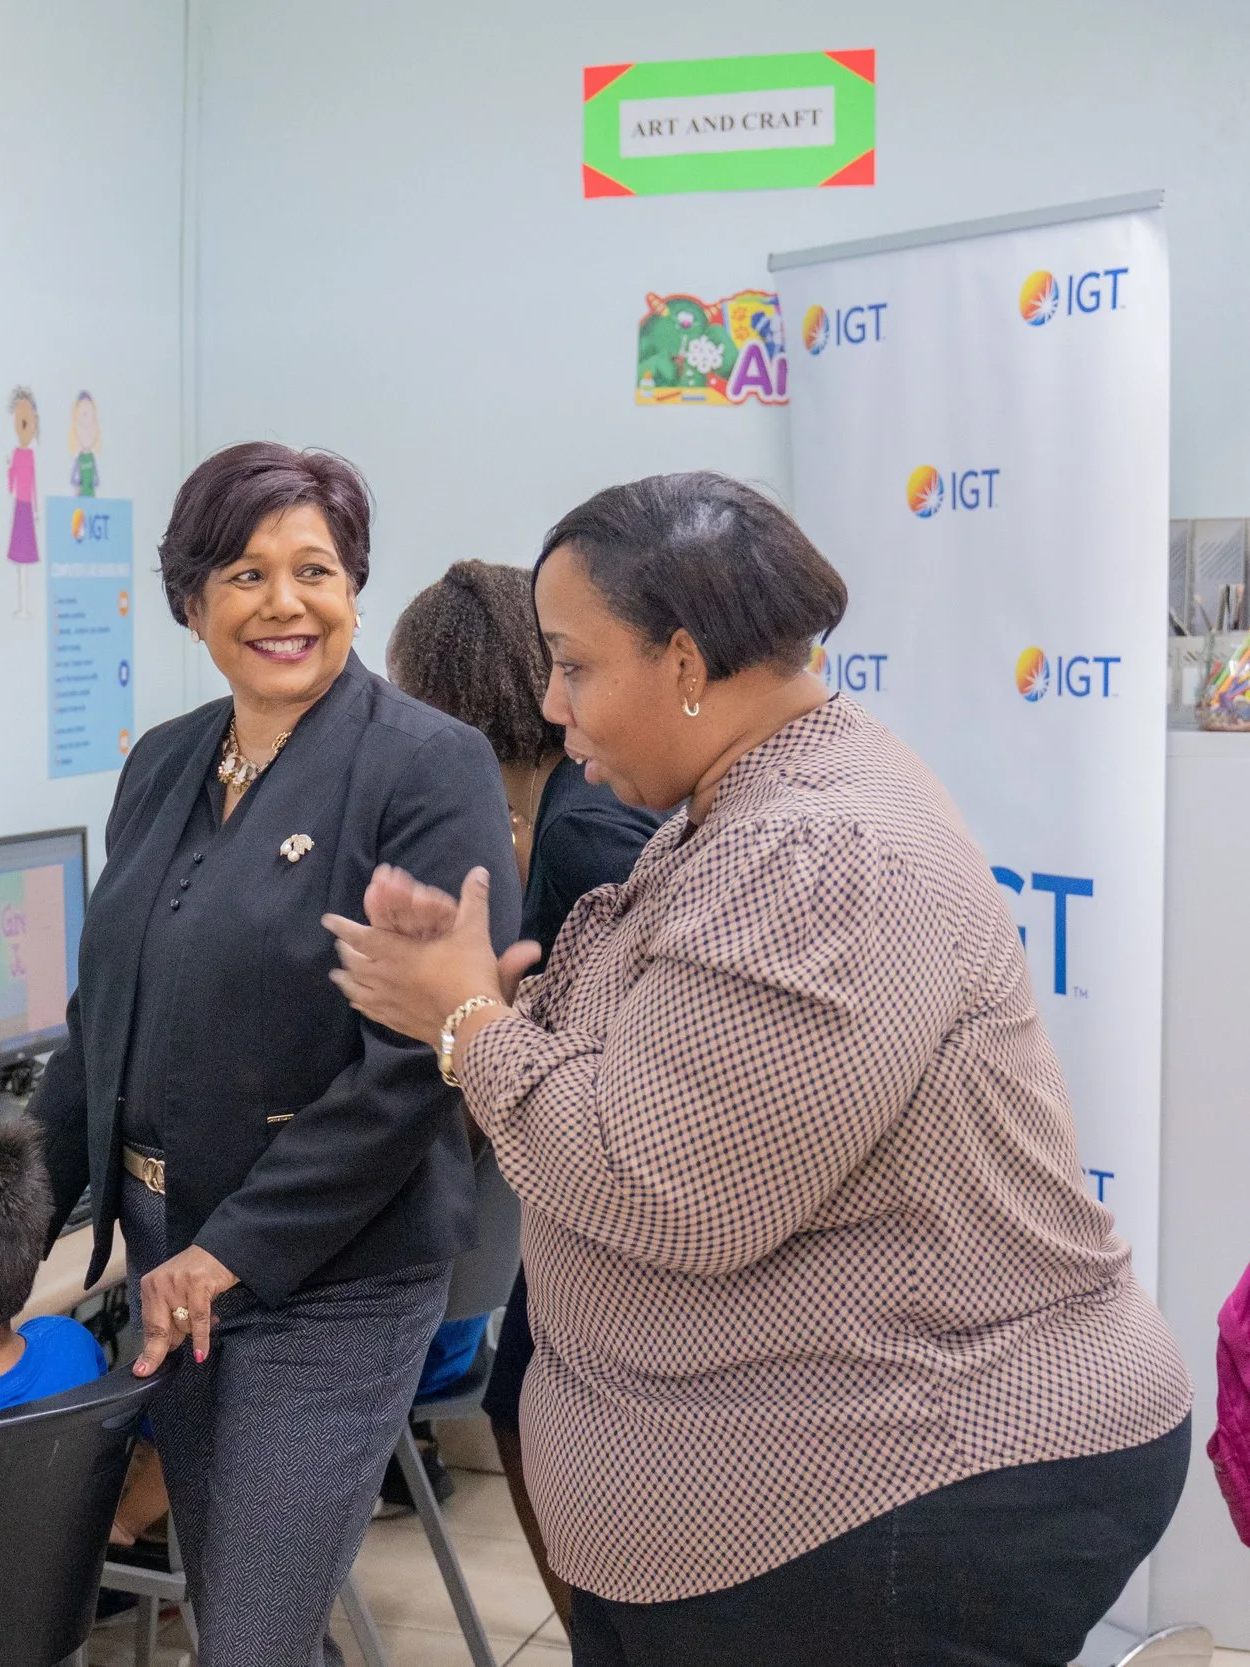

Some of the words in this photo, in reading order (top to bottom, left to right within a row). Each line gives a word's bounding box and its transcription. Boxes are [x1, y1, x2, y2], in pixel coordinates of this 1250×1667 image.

[632, 119, 680, 139] ART
[686, 115, 735, 135] AND
[742, 108, 824, 132] CRAFT
[1067, 267, 1129, 316] IGT
[836, 302, 888, 346] IGT
[951, 468, 1001, 511] IGT
[88, 513, 110, 541] IGT
[838, 653, 888, 692] IGT
[1057, 655, 1122, 697] IGT
